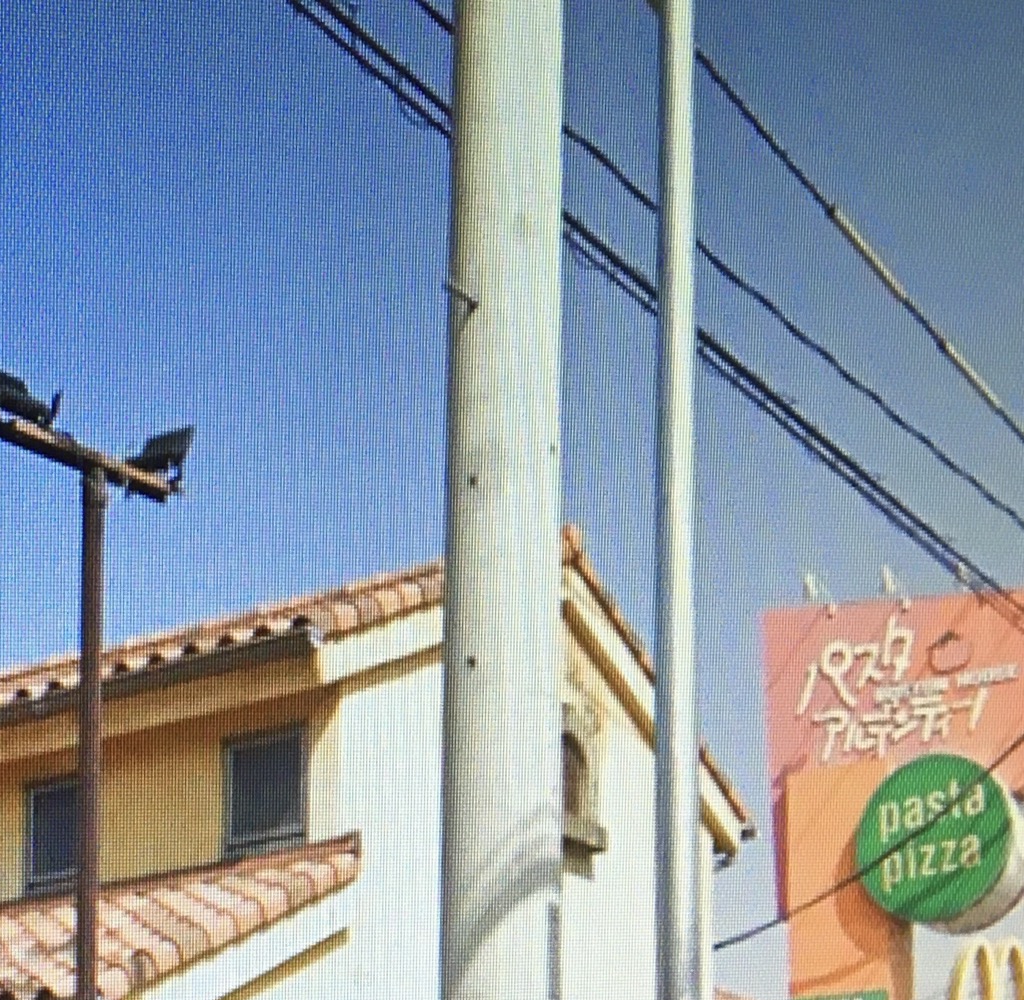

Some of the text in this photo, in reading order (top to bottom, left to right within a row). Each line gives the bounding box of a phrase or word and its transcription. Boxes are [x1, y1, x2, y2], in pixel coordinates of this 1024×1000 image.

[796, 614, 914, 714] パスタ
[878, 781, 986, 836] pasta
[880, 830, 982, 891] pizza
